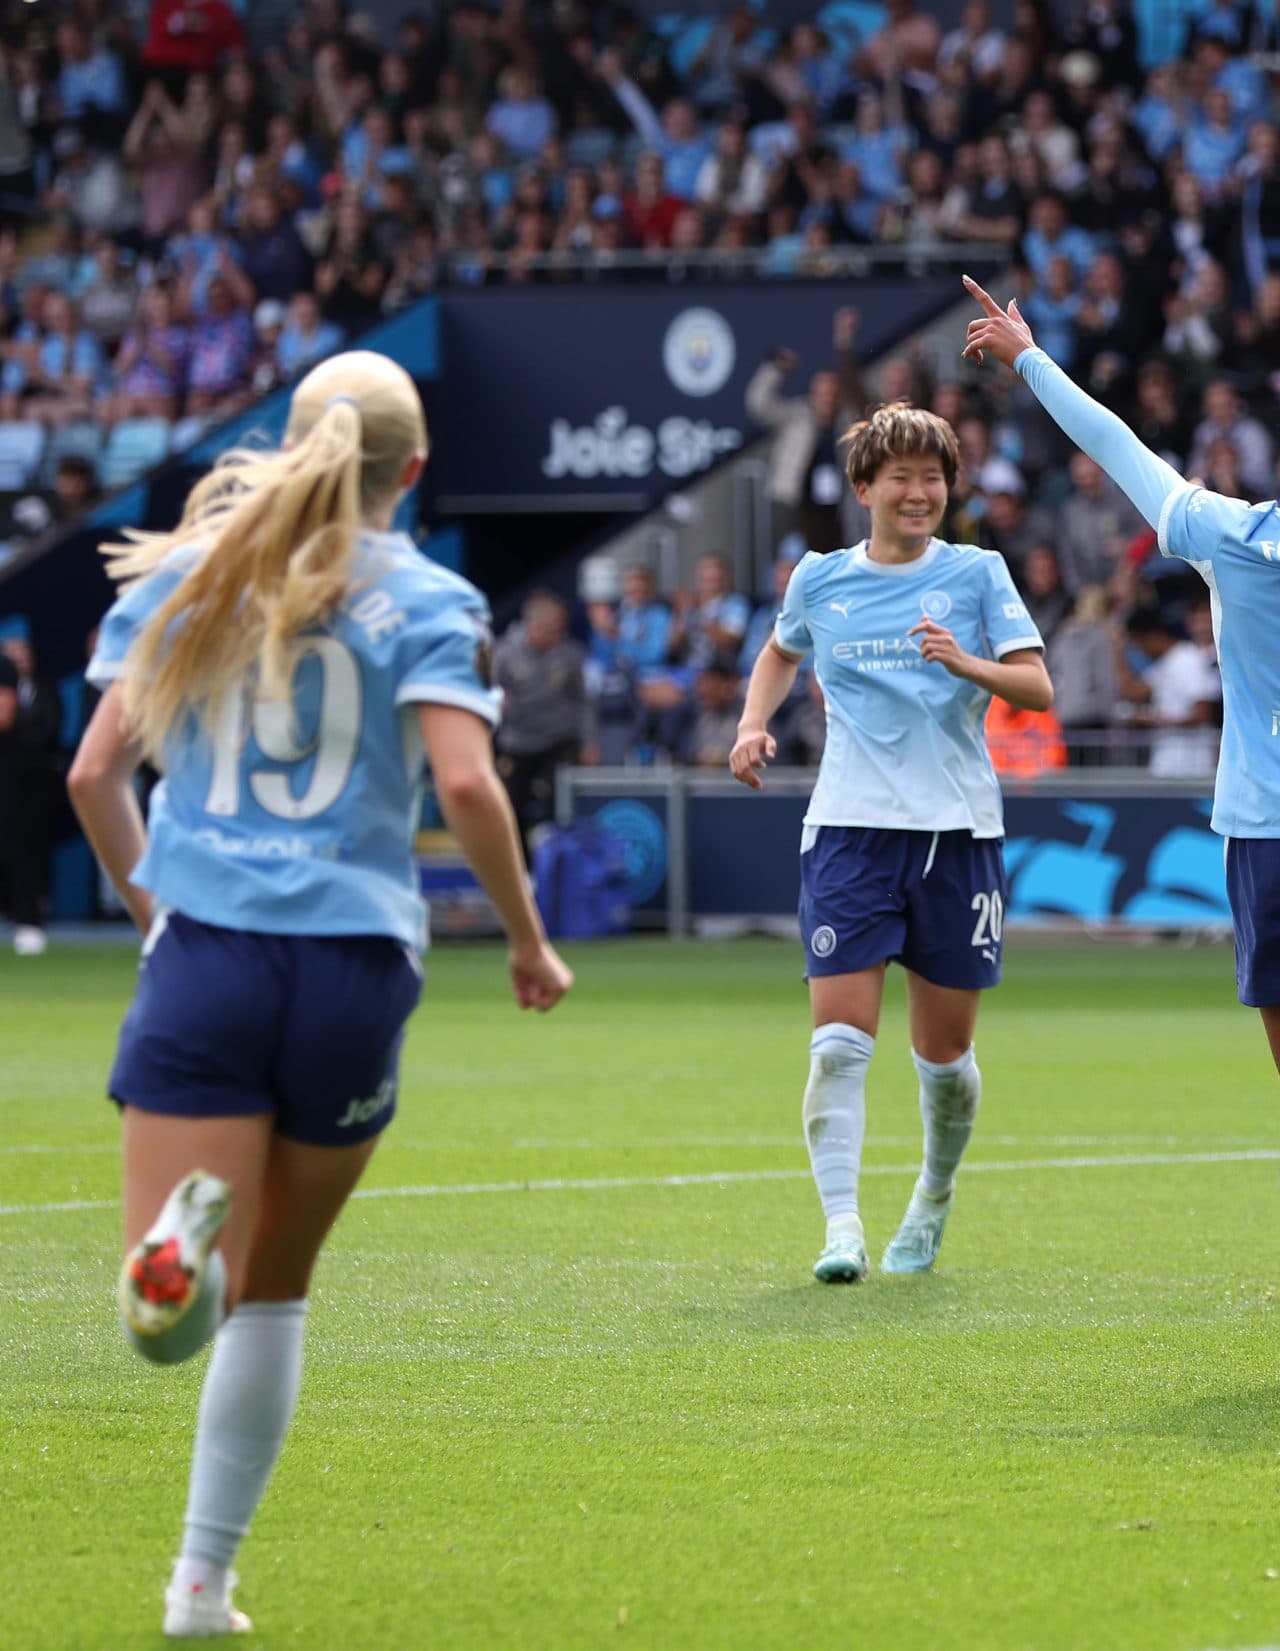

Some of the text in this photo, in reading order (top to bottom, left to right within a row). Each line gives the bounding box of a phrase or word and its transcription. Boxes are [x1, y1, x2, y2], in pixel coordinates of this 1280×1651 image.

[543, 407, 654, 478] Joie
[832, 638, 922, 661] ETIHA
[203, 634, 363, 821] 19
[971, 889, 1003, 947] 20
